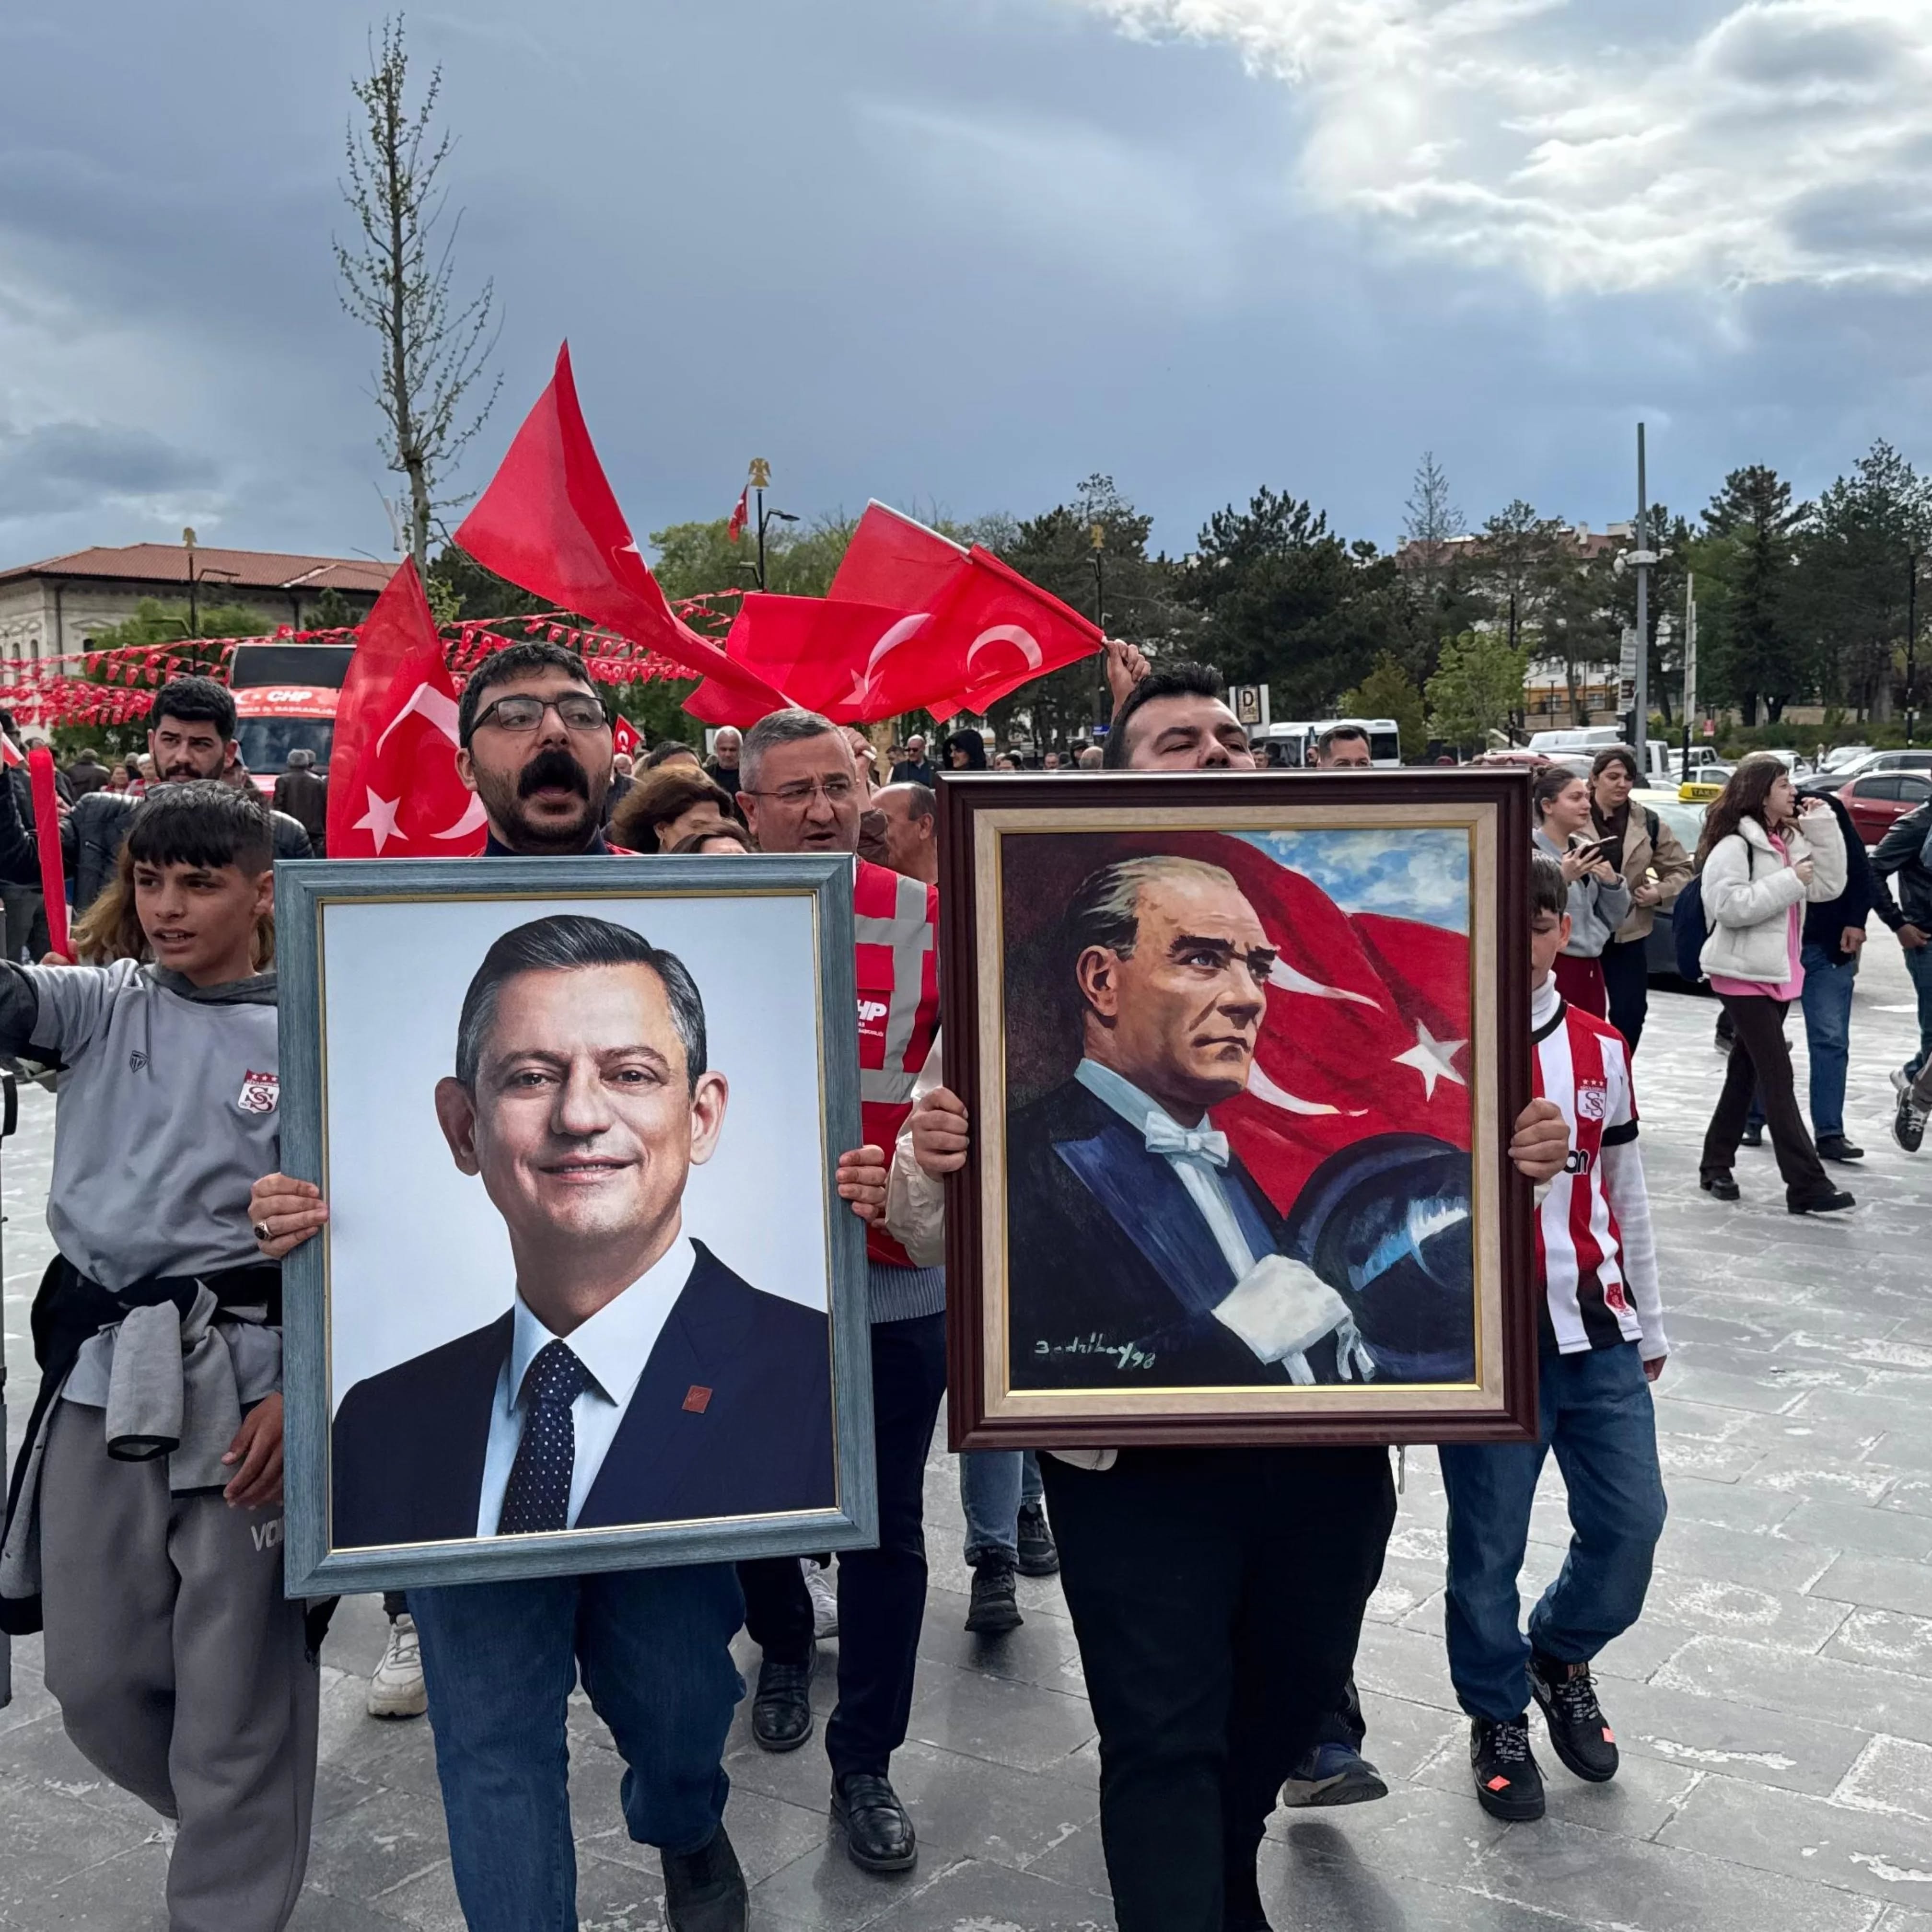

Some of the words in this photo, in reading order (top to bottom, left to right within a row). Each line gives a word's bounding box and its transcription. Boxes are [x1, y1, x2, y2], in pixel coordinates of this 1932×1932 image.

[267, 690, 313, 702] CHP
[1243, 691, 1254, 707] D
[857, 999, 887, 1022] HP
